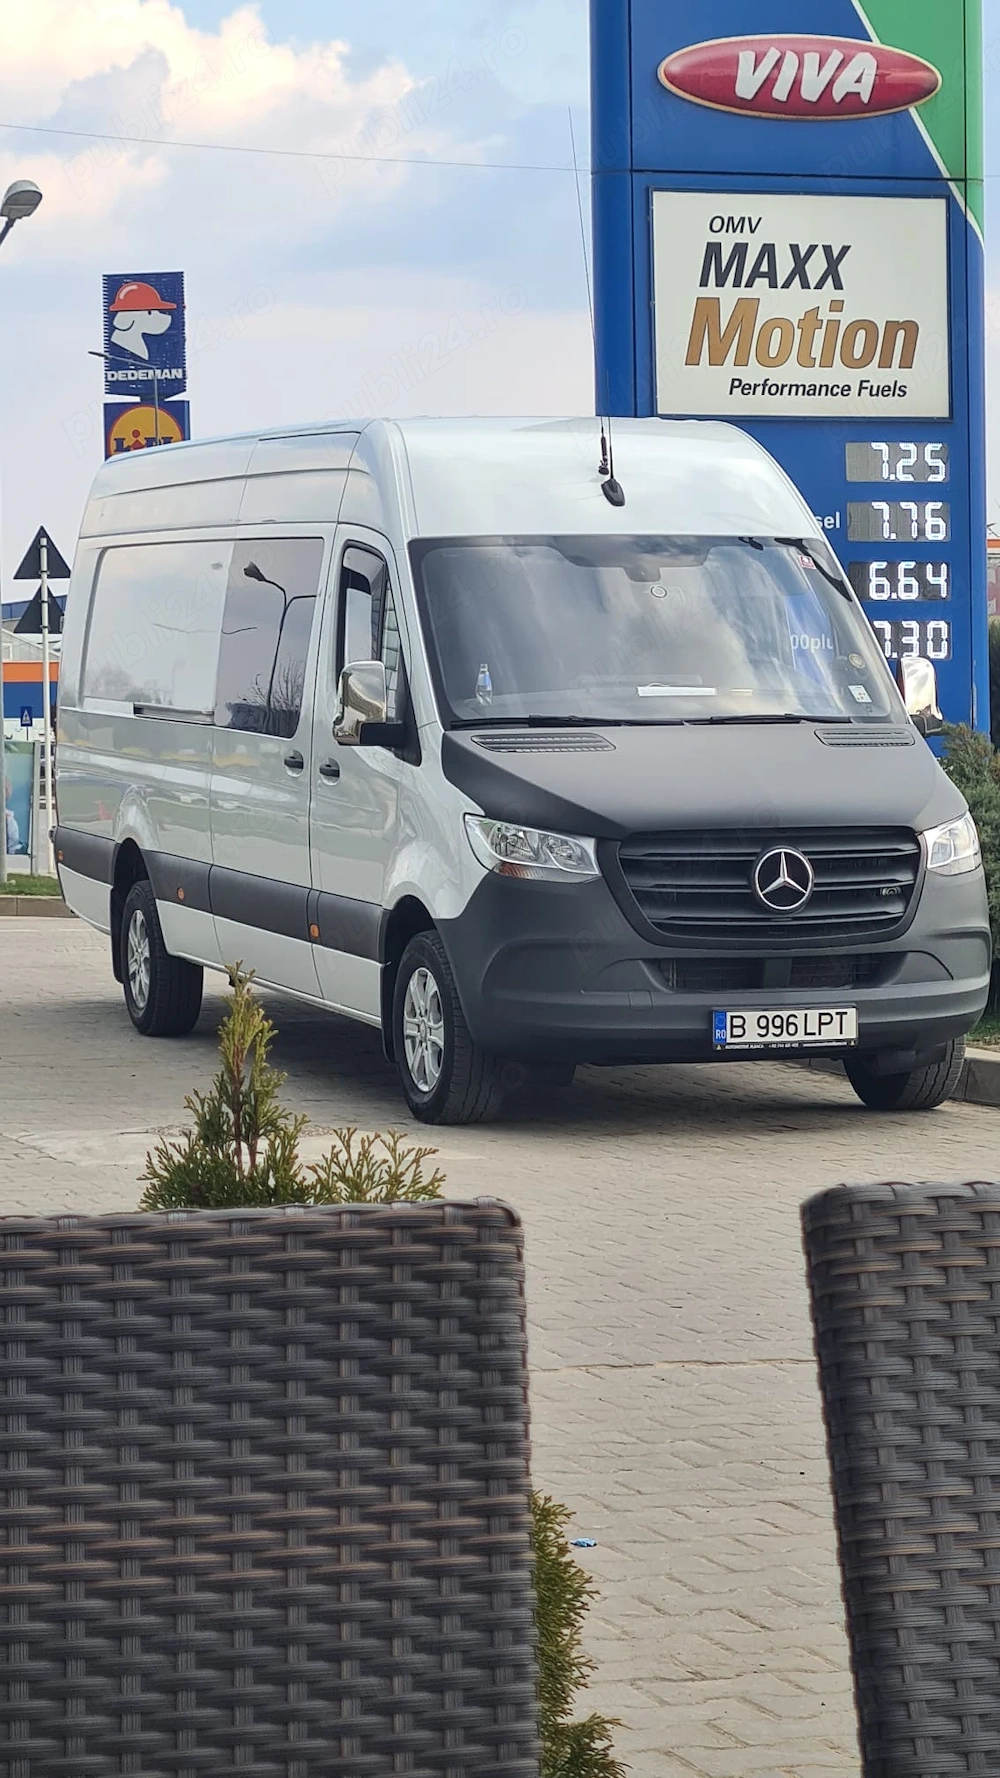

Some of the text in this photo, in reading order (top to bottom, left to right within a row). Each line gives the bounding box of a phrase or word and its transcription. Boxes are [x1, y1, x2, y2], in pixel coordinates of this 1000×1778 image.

[734, 47, 879, 104] VIVA
[708, 215, 762, 234] OMV
[698, 241, 852, 291] MAXX
[684, 296, 920, 369] Motion
[107, 368, 183, 381] DEDEMAN
[729, 378, 908, 398] Performance Fuels
[870, 442, 946, 482] 7.25
[871, 501, 947, 541] 7.76
[869, 561, 948, 601] 6.64
[873, 620, 948, 658] 7.30
[715, 1012, 848, 1039] RO B 996 LPT
